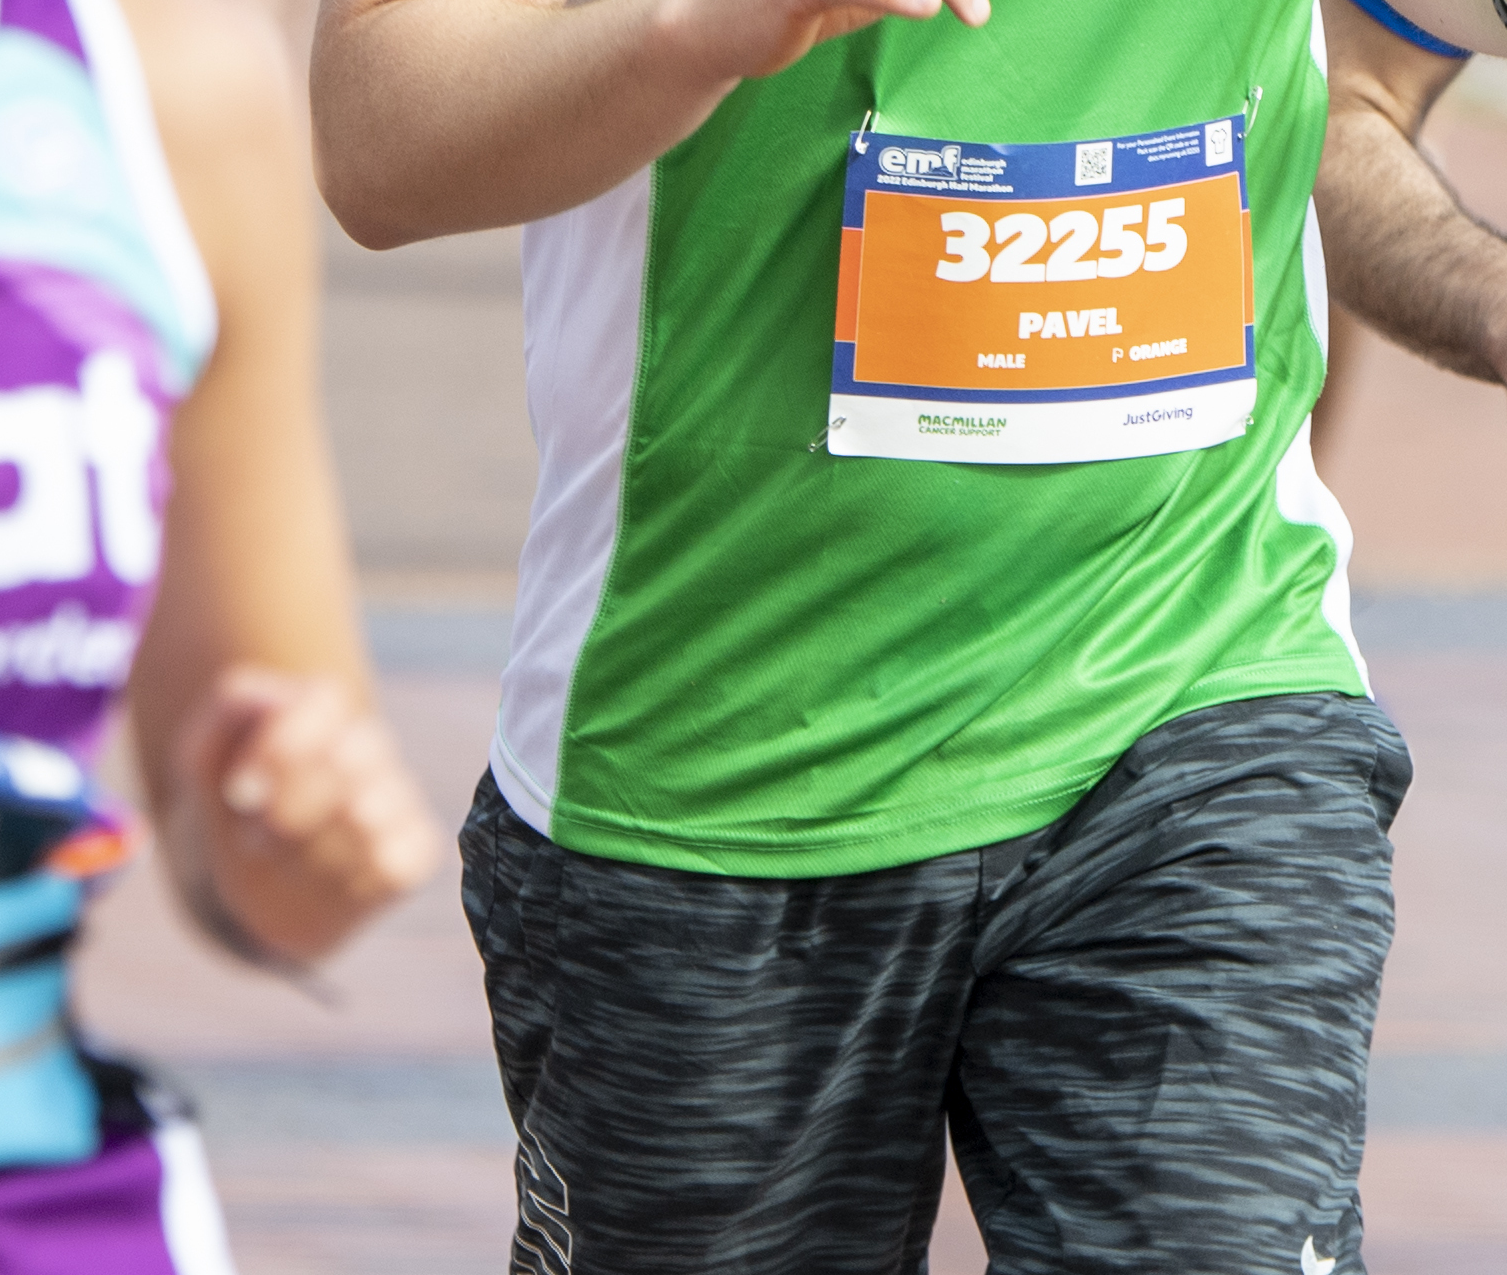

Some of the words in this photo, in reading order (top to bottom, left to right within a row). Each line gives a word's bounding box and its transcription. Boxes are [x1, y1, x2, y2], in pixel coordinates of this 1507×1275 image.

[879, 145, 961, 180] emf
[935, 197, 1188, 283] 32255
[1018, 307, 1123, 339] PAVEL
[977, 353, 1026, 369] MALE
[1129, 338, 1187, 362] ORANGE
[917, 413, 1007, 428] MACMILLAN
[918, 426, 957, 436] CANCER
[958, 427, 1002, 437] SUPPORT
[1122, 407, 1194, 427] JustGiving
